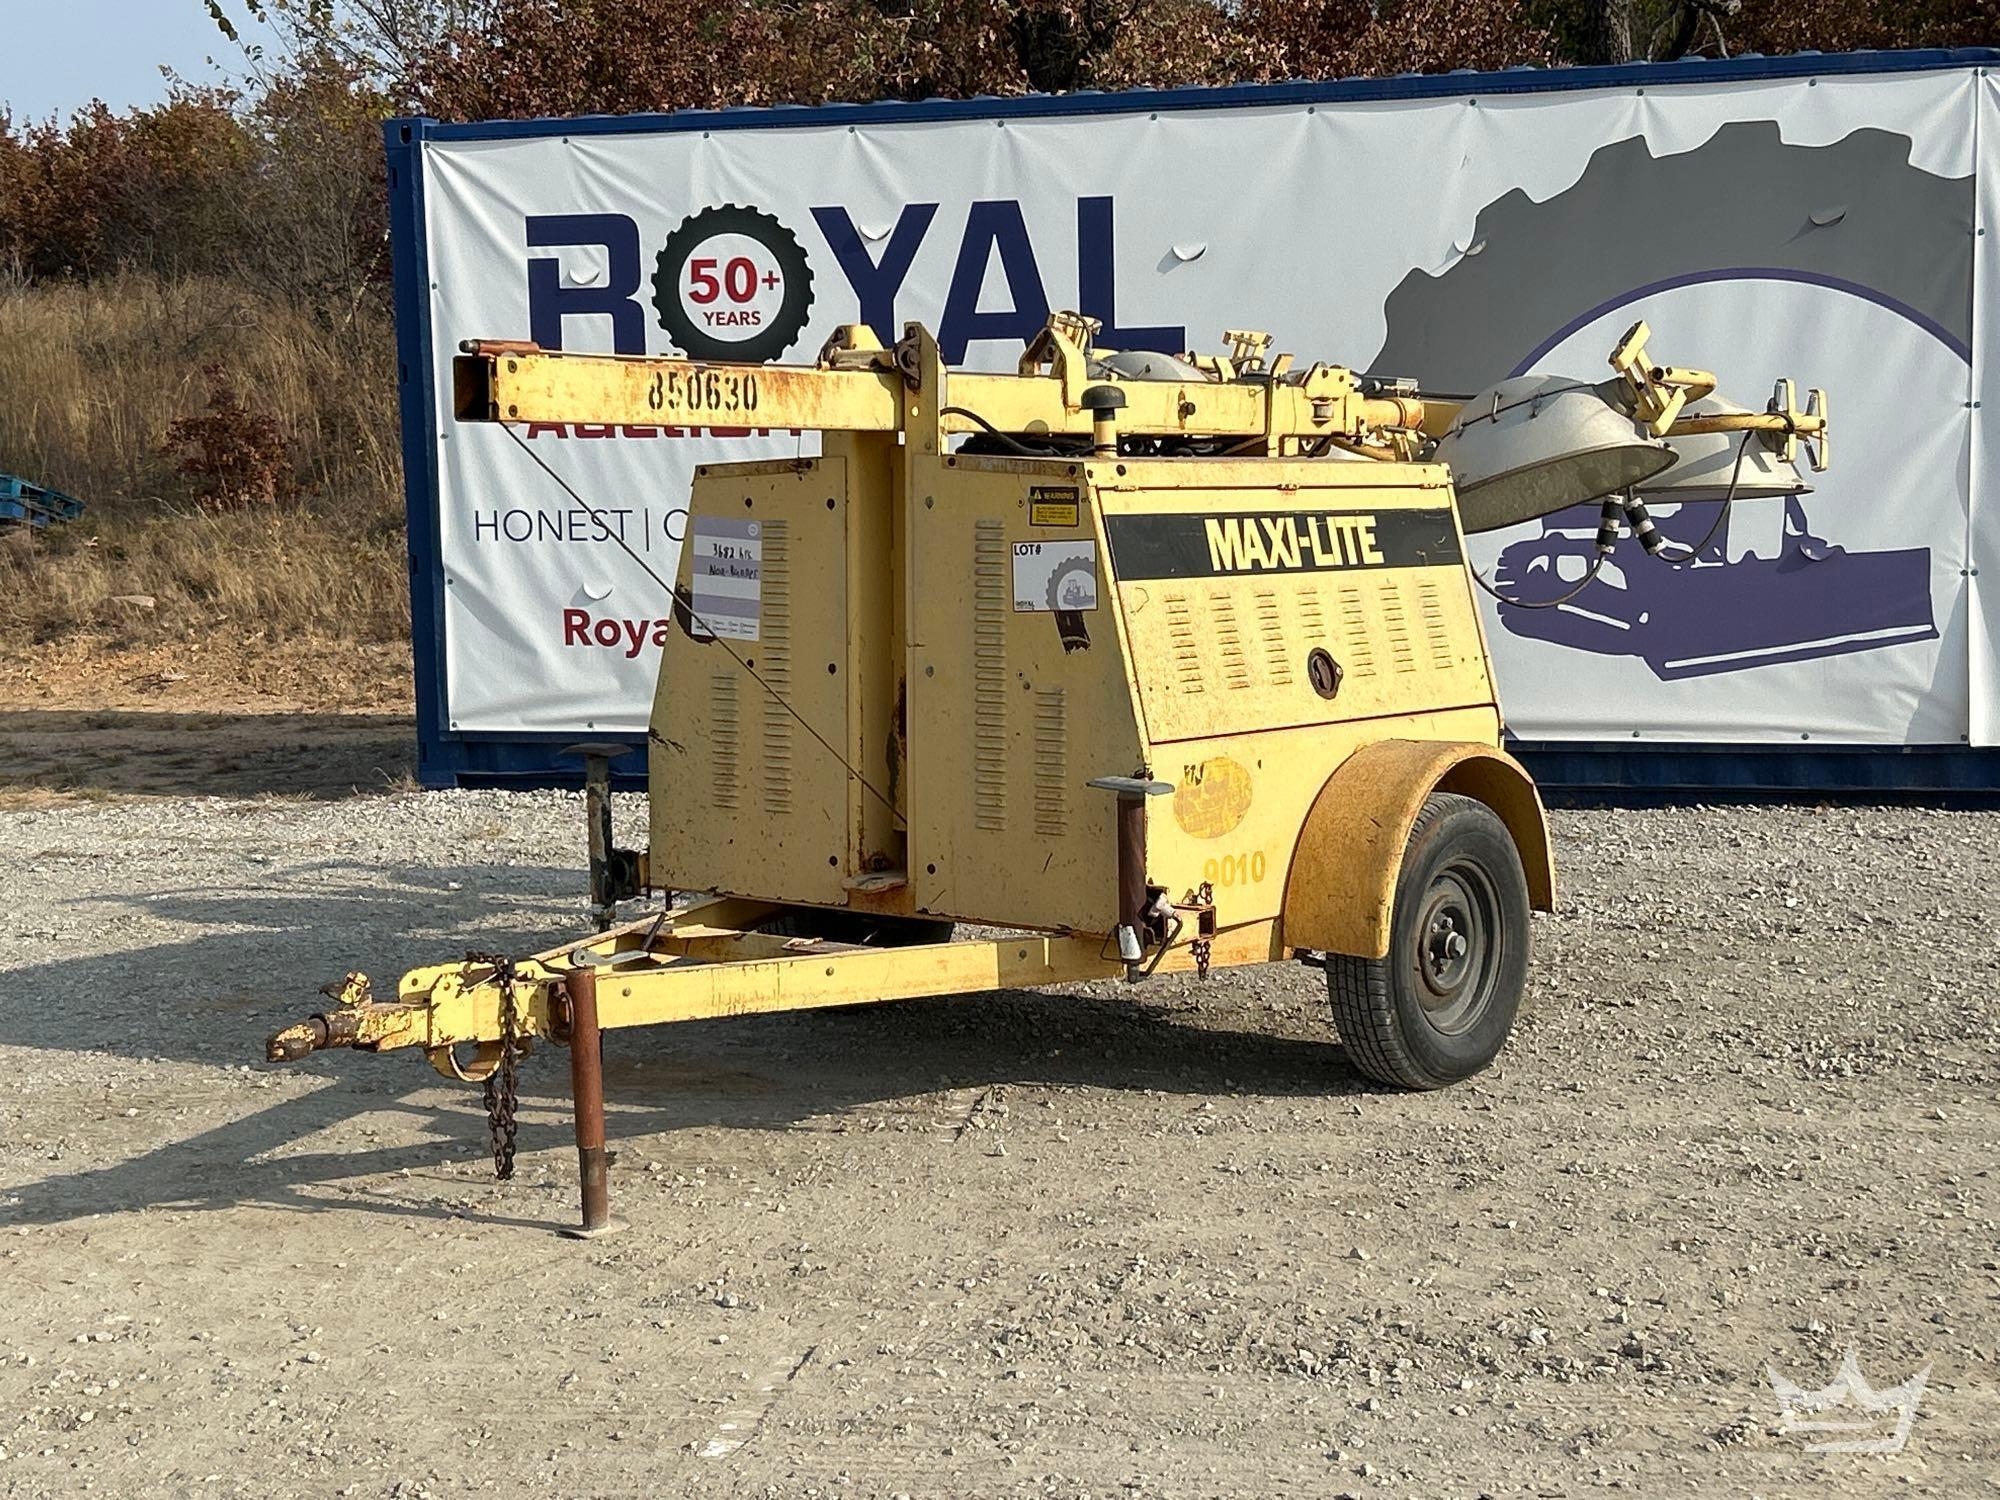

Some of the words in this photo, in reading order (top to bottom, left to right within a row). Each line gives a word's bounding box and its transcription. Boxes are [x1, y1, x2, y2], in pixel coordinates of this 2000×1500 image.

[688, 256, 781, 305] 50+
[703, 311, 762, 326] YEARS
[648, 371, 758, 411] 850630
[474, 508, 633, 542] HONEST
[1204, 515, 1385, 572] MAXI-LITE
[1014, 544, 1041, 556] LOT#
[1203, 850, 1266, 887] 9010
